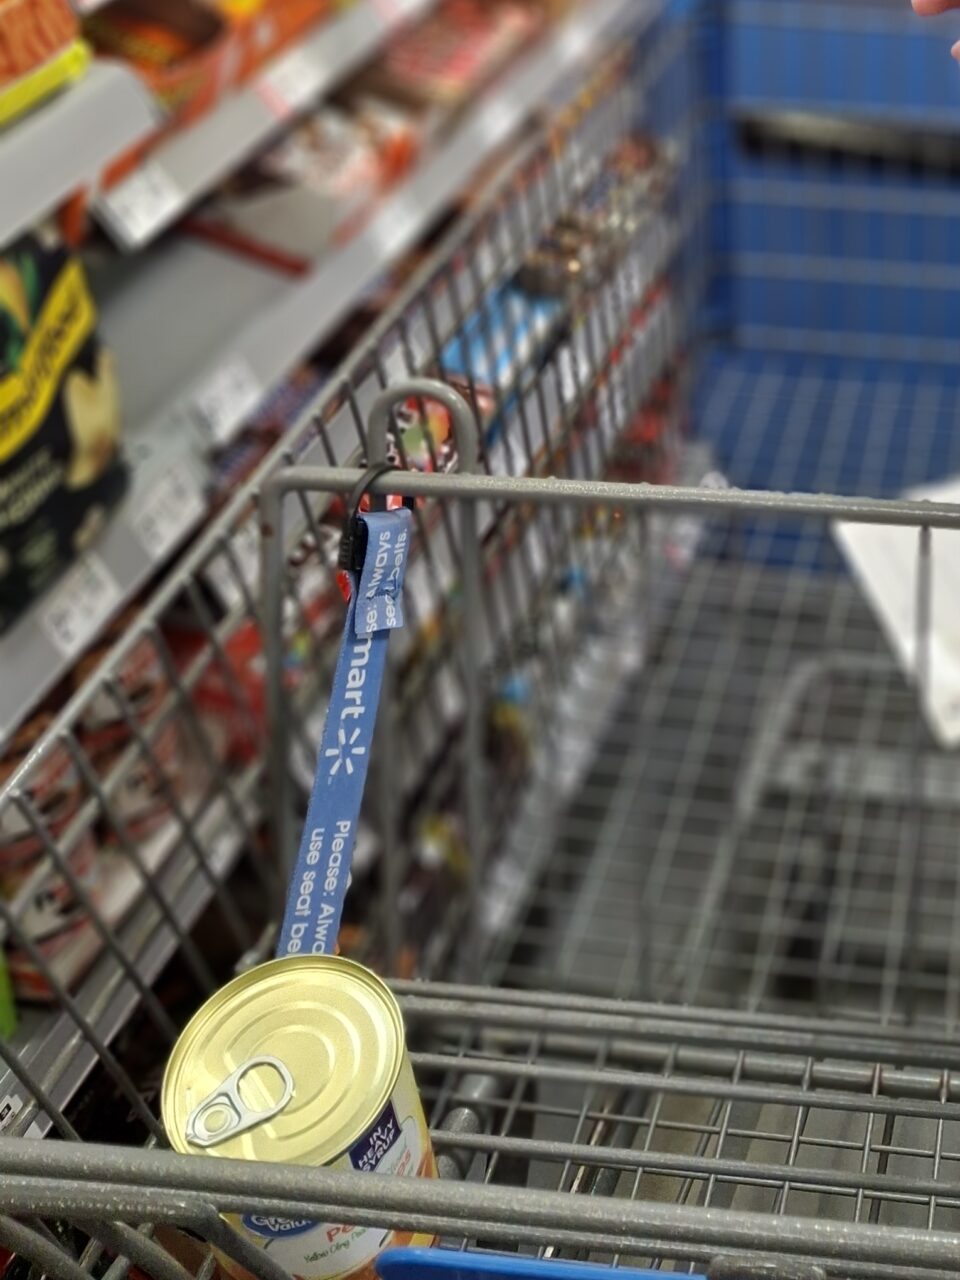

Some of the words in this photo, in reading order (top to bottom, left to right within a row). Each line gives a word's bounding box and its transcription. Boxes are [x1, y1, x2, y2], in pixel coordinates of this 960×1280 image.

[365, 530, 392, 600] Always
[306, 827, 325, 866] use
[323, 820, 352, 897] Please:
[294, 870, 317, 917] seat
[358, 1118, 394, 1169] HEAVY
[362, 1127, 395, 1172] SYRUP
[369, 1126, 382, 1146] IN
